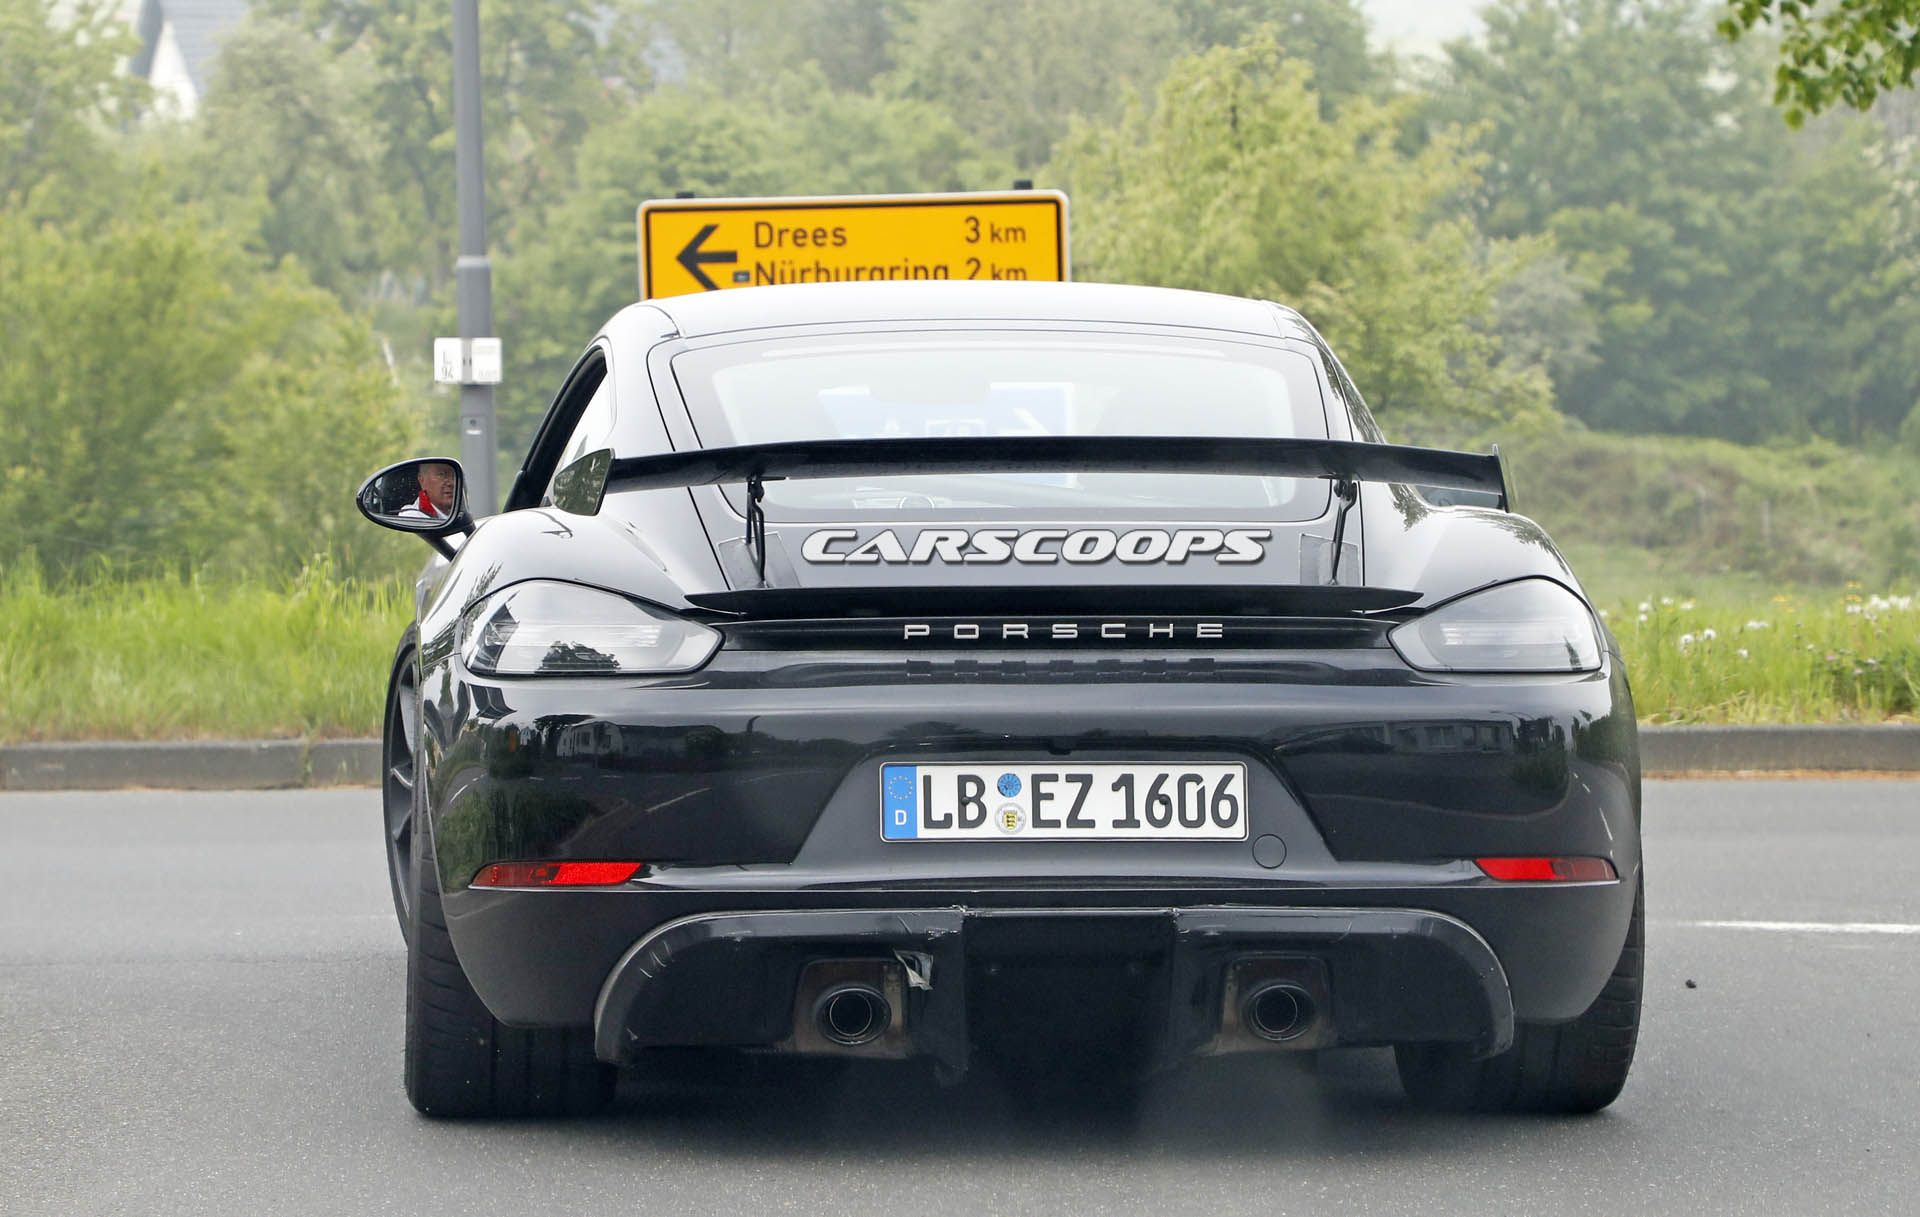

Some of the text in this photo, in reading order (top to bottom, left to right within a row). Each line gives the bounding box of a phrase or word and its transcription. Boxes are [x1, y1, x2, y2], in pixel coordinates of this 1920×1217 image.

[754, 215, 1027, 249] Drees 3 km
[965, 257, 982, 280] 2
[991, 263, 1028, 281] km
[903, 622, 1224, 640] PORSCHE
[922, 773, 1240, 829] LB EZ 1606
[894, 810, 907, 825] D
